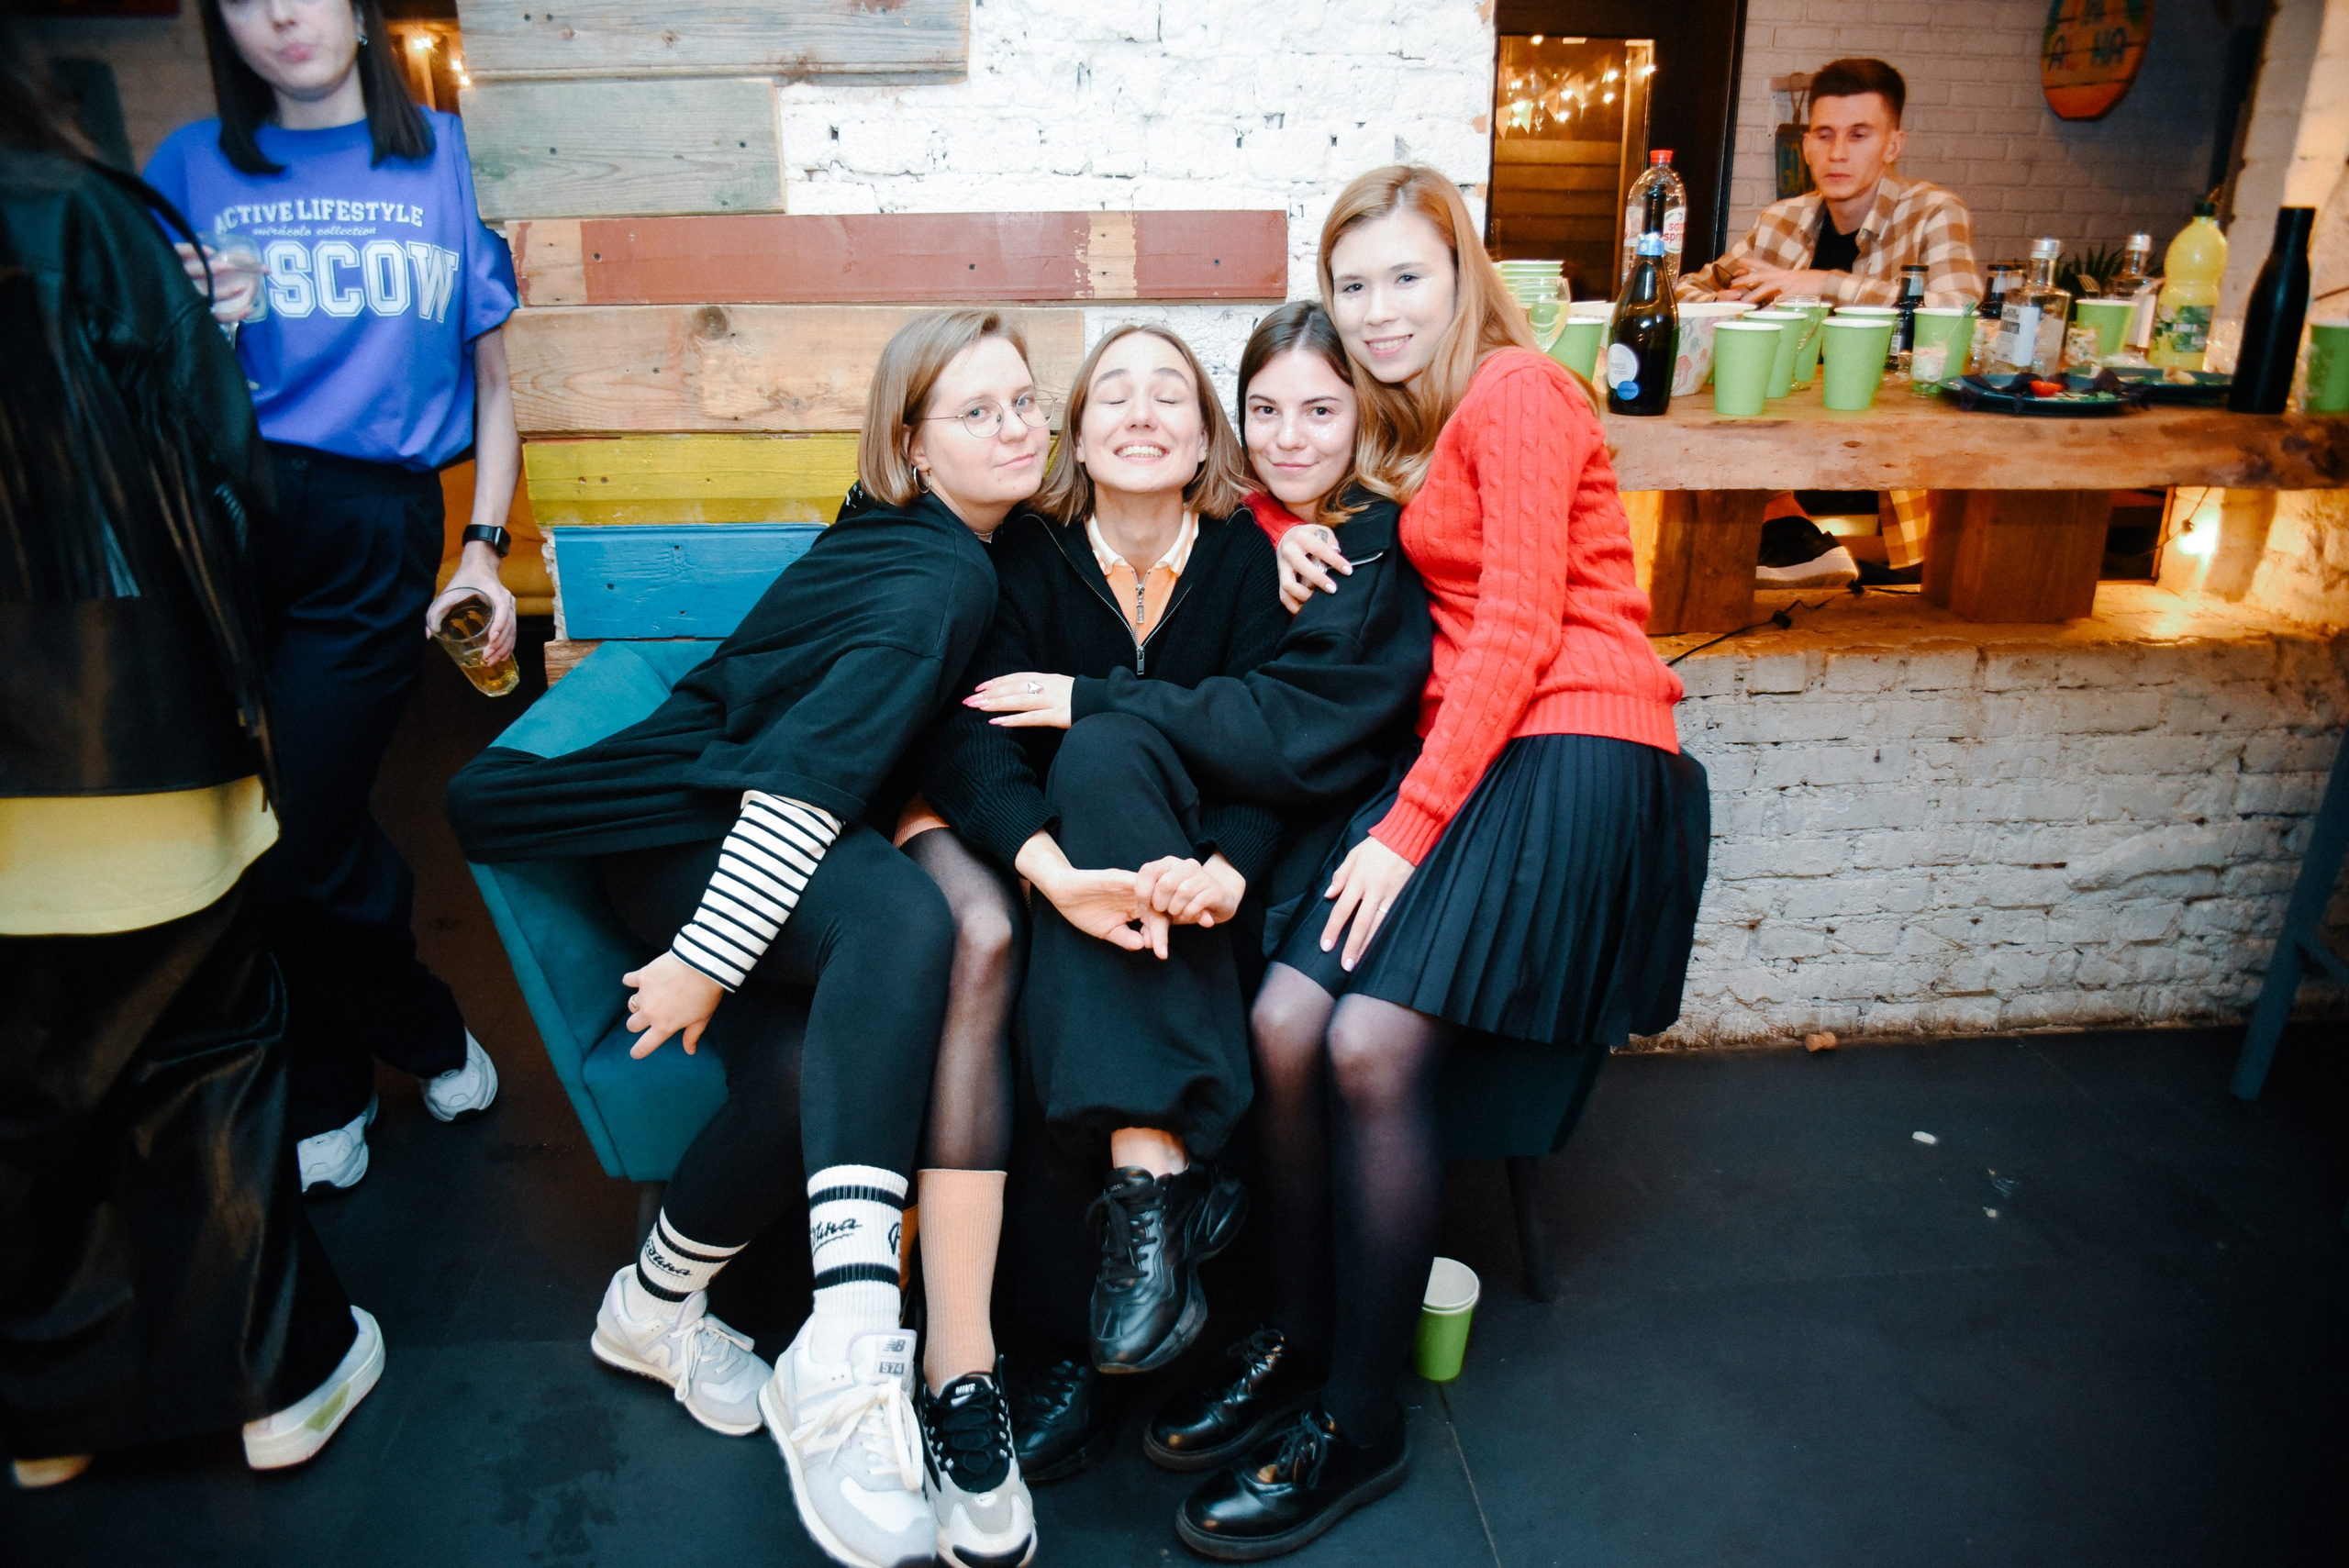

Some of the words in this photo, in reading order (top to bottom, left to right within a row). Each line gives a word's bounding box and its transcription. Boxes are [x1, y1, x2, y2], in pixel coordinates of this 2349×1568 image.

[214, 200, 295, 234] ACTIVE
[295, 197, 424, 228] LIFESTYLE
[316, 225, 377, 236] collection
[262, 239, 460, 324] SCOW
[881, 1362, 904, 1373] 574
[955, 1383, 976, 1395] NIKE
